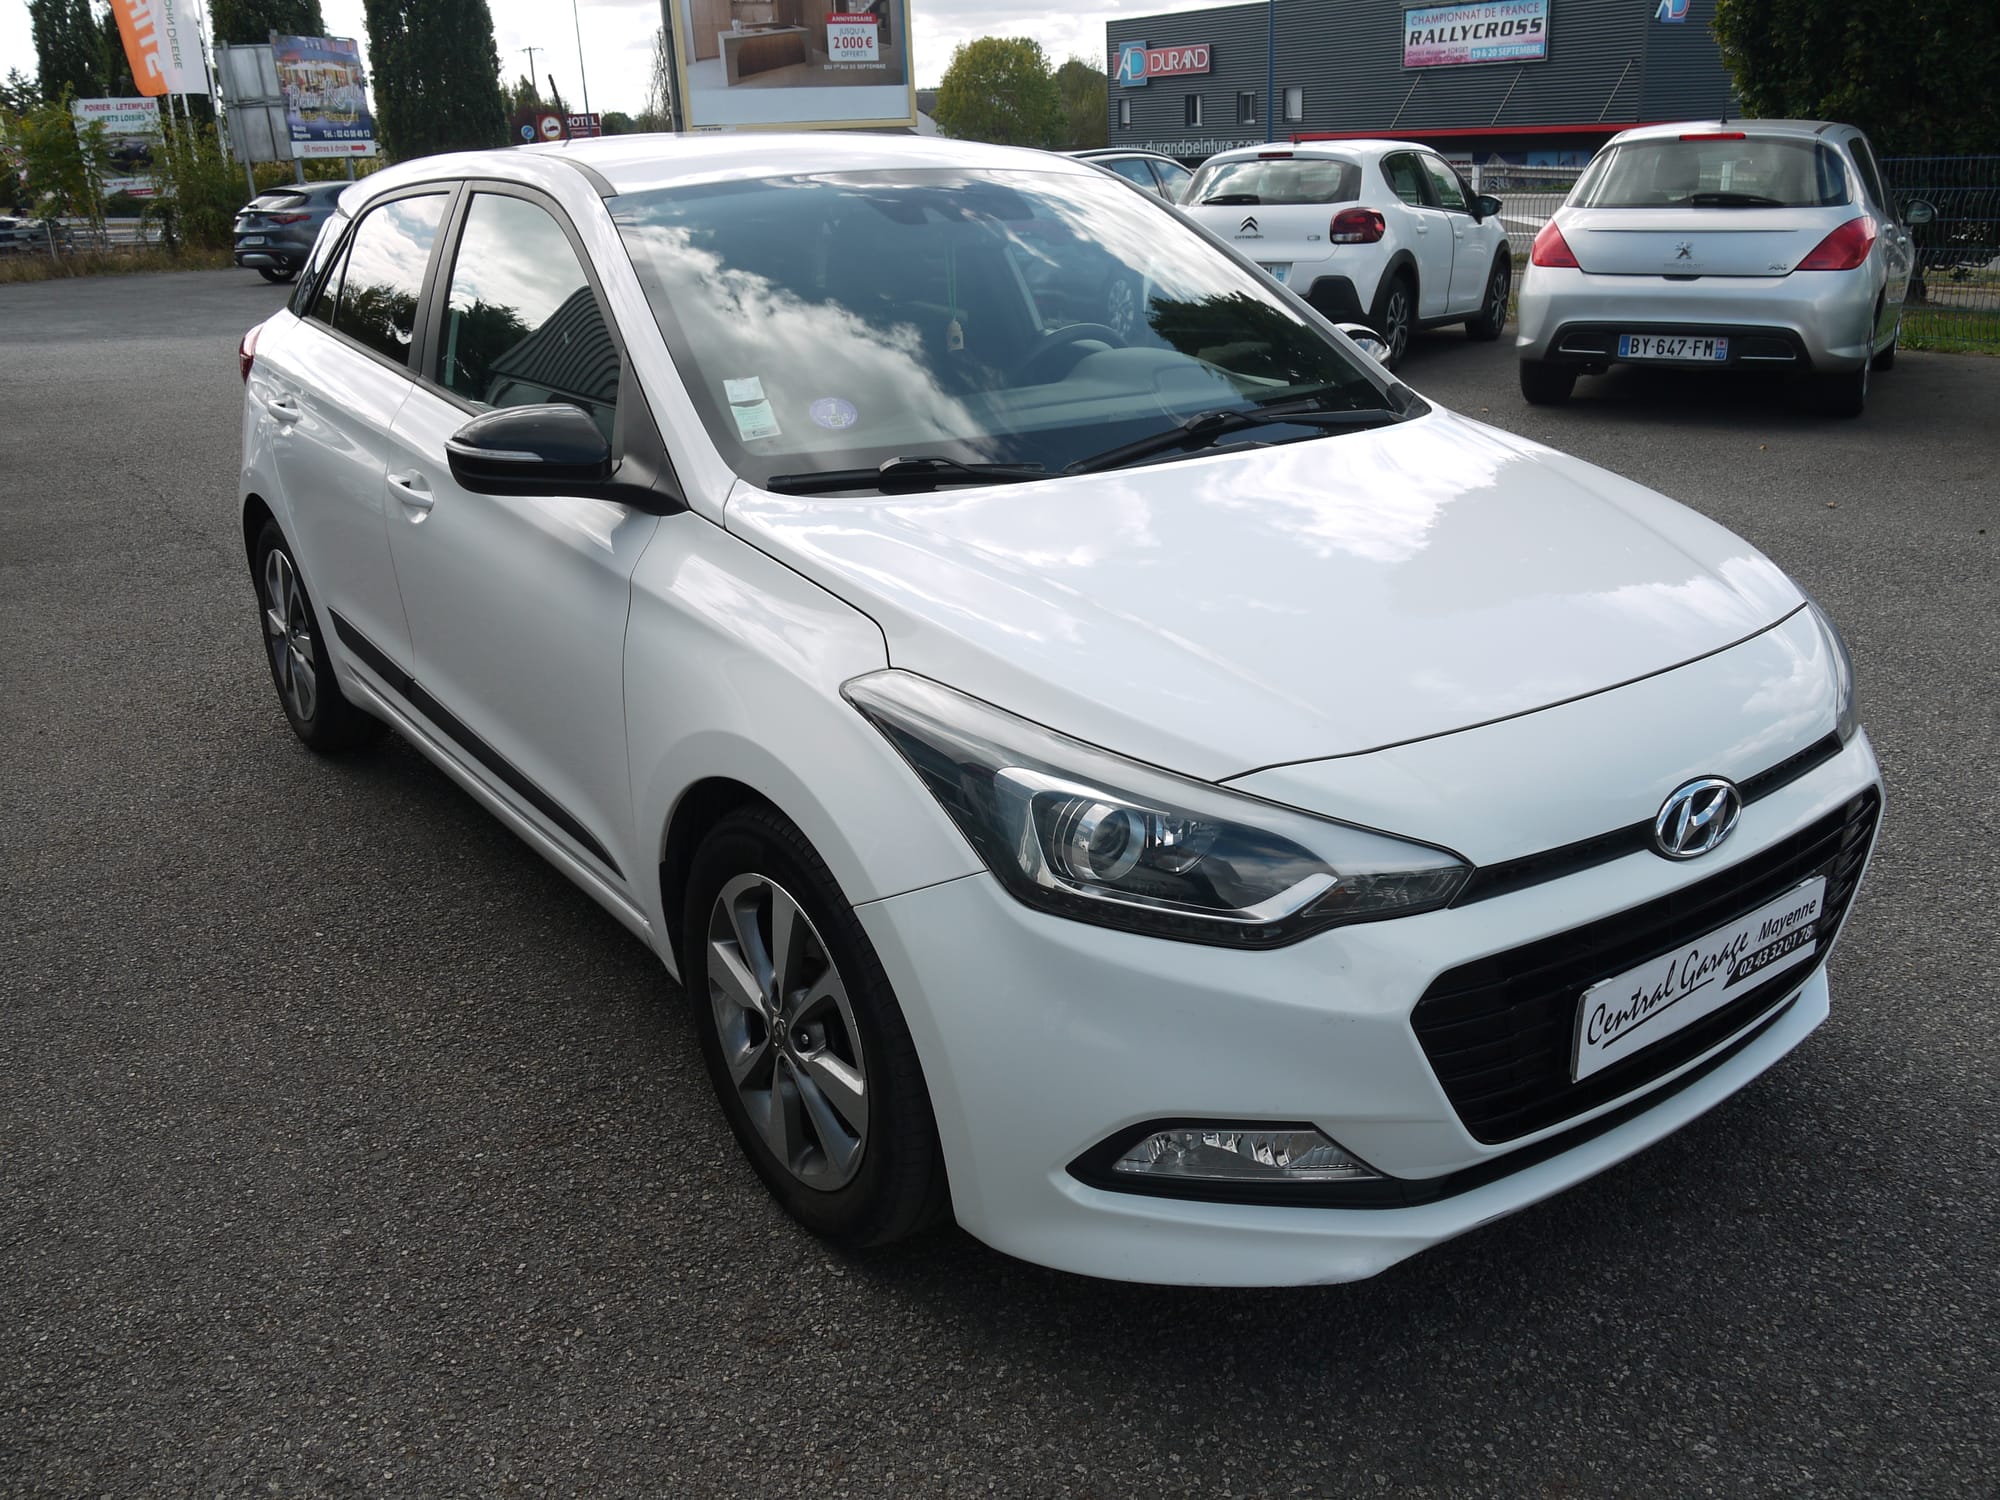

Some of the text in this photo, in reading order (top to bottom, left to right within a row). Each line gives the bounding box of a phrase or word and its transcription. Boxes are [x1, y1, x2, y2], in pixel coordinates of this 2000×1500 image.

[1411, 3, 1539, 26] CHAMPIONNAT DE FRANCE
[866, 36, 873, 49] €
[1408, 17, 1544, 46] RALLYCROSS
[841, 50, 867, 58] OFFERTS
[1150, 49, 1208, 72] DURAND
[1488, 47, 1497, 57] 20
[1498, 44, 1541, 56] SEPTEMBRE
[120, 114, 145, 122] LOISIRS
[1630, 337, 1714, 358] BY-647-FM
[1757, 899, 1817, 943] Mayenne
[1740, 956, 1755, 976] 02
[1754, 949, 1769, 967] 43
[1769, 940, 1784, 960] 32
[1587, 931, 1749, 1046] Central Garage
